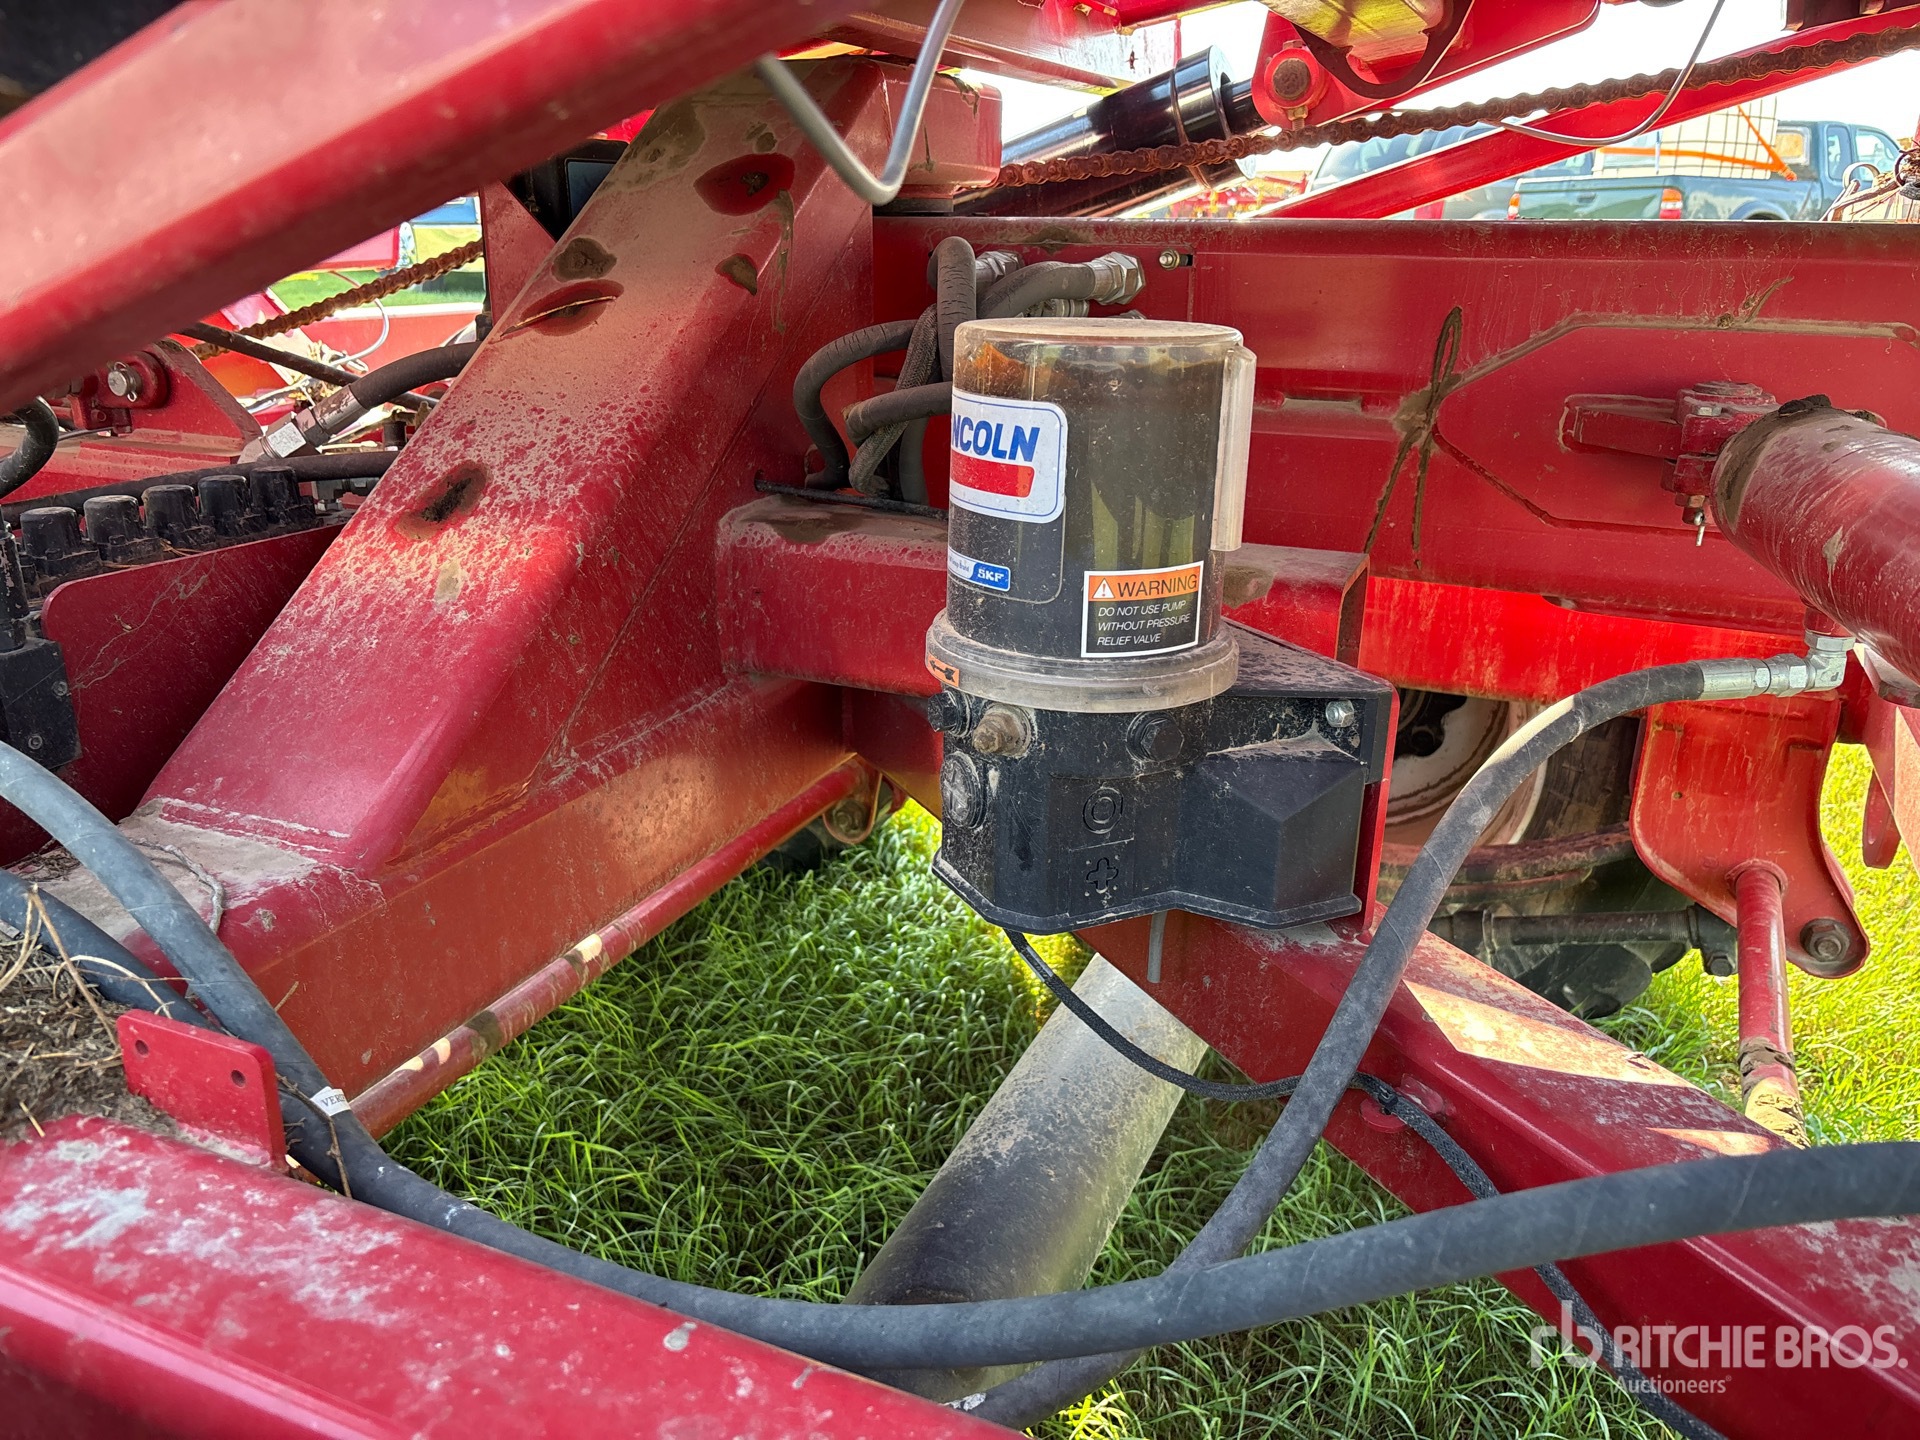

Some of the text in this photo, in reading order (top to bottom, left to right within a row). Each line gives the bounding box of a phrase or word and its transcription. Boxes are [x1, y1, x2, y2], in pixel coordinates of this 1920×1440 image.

[977, 568, 1004, 582] SKF
[1117, 574, 1197, 598] WARNING
[1098, 600, 1187, 617] DO NOT USE PUMP
[1098, 613, 1191, 631] WITHOUT PRESSURE
[1097, 633, 1162, 646] RELIEF VALVE
